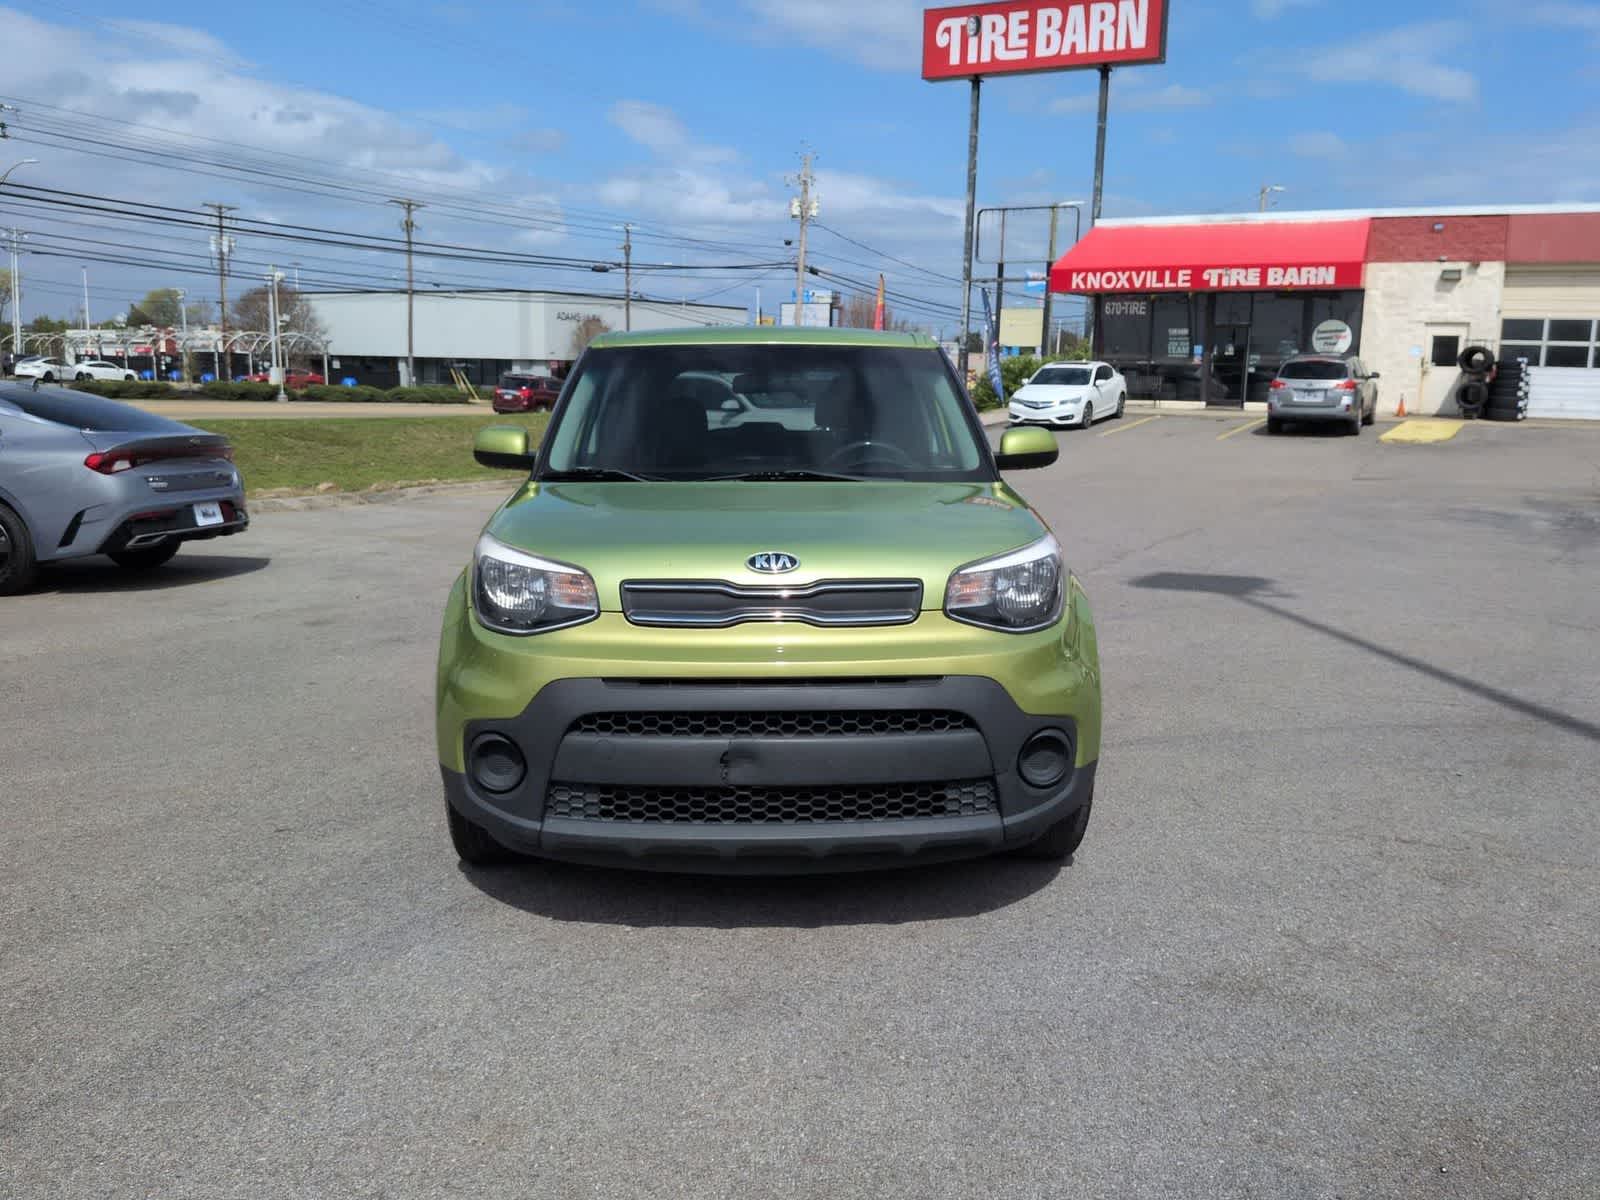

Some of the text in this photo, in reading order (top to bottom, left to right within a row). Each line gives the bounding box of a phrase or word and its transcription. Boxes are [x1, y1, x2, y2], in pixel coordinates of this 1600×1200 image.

[1035, 0, 1149, 58] BARN
[1071, 269, 1192, 289] KNOXVILLE
[1267, 266, 1336, 286] BARN
[1105, 301, 1147, 315] 670-TIRE
[755, 553, 792, 570] KIA
